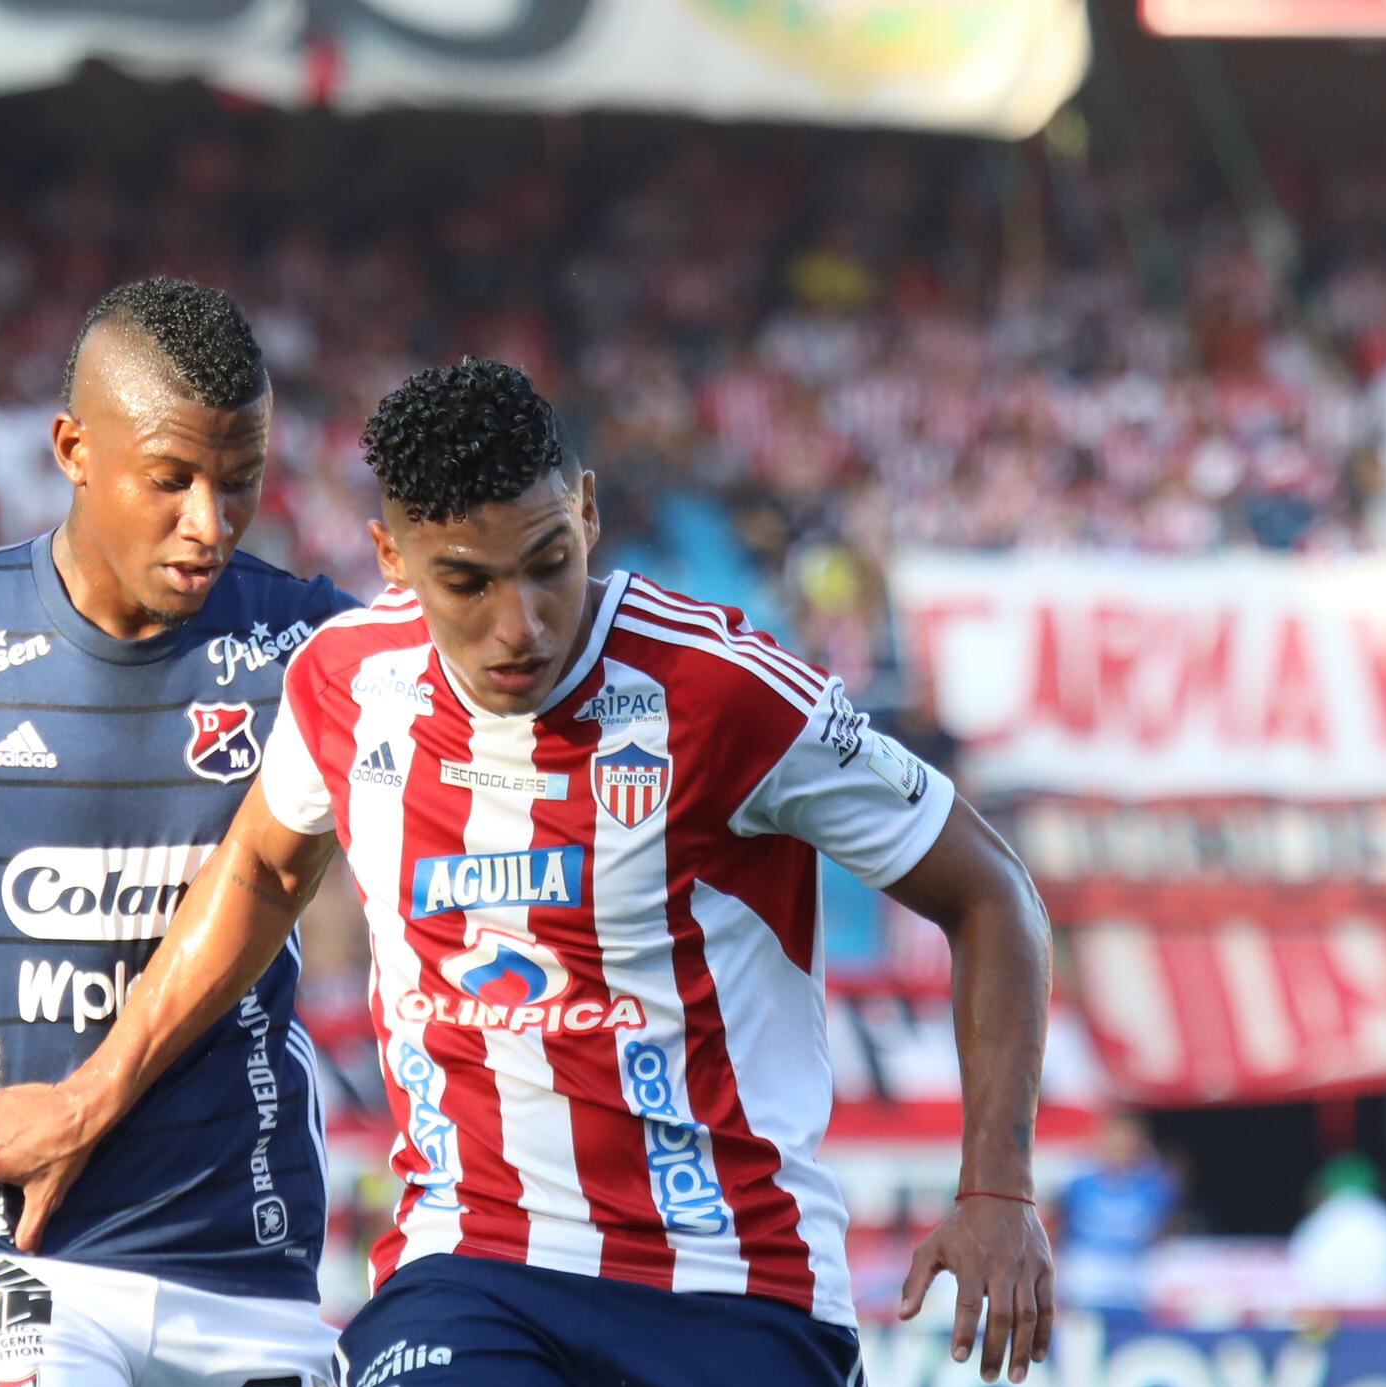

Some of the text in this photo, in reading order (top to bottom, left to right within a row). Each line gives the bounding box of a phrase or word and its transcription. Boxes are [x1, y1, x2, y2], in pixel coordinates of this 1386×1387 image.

[207, 618, 314, 687] Pilsen
[351, 766, 404, 789] adidas
[605, 771, 659, 786] JUNIOR
[424, 850, 571, 914] AGUILA
[395, 990, 644, 1034] OLIMPICA
